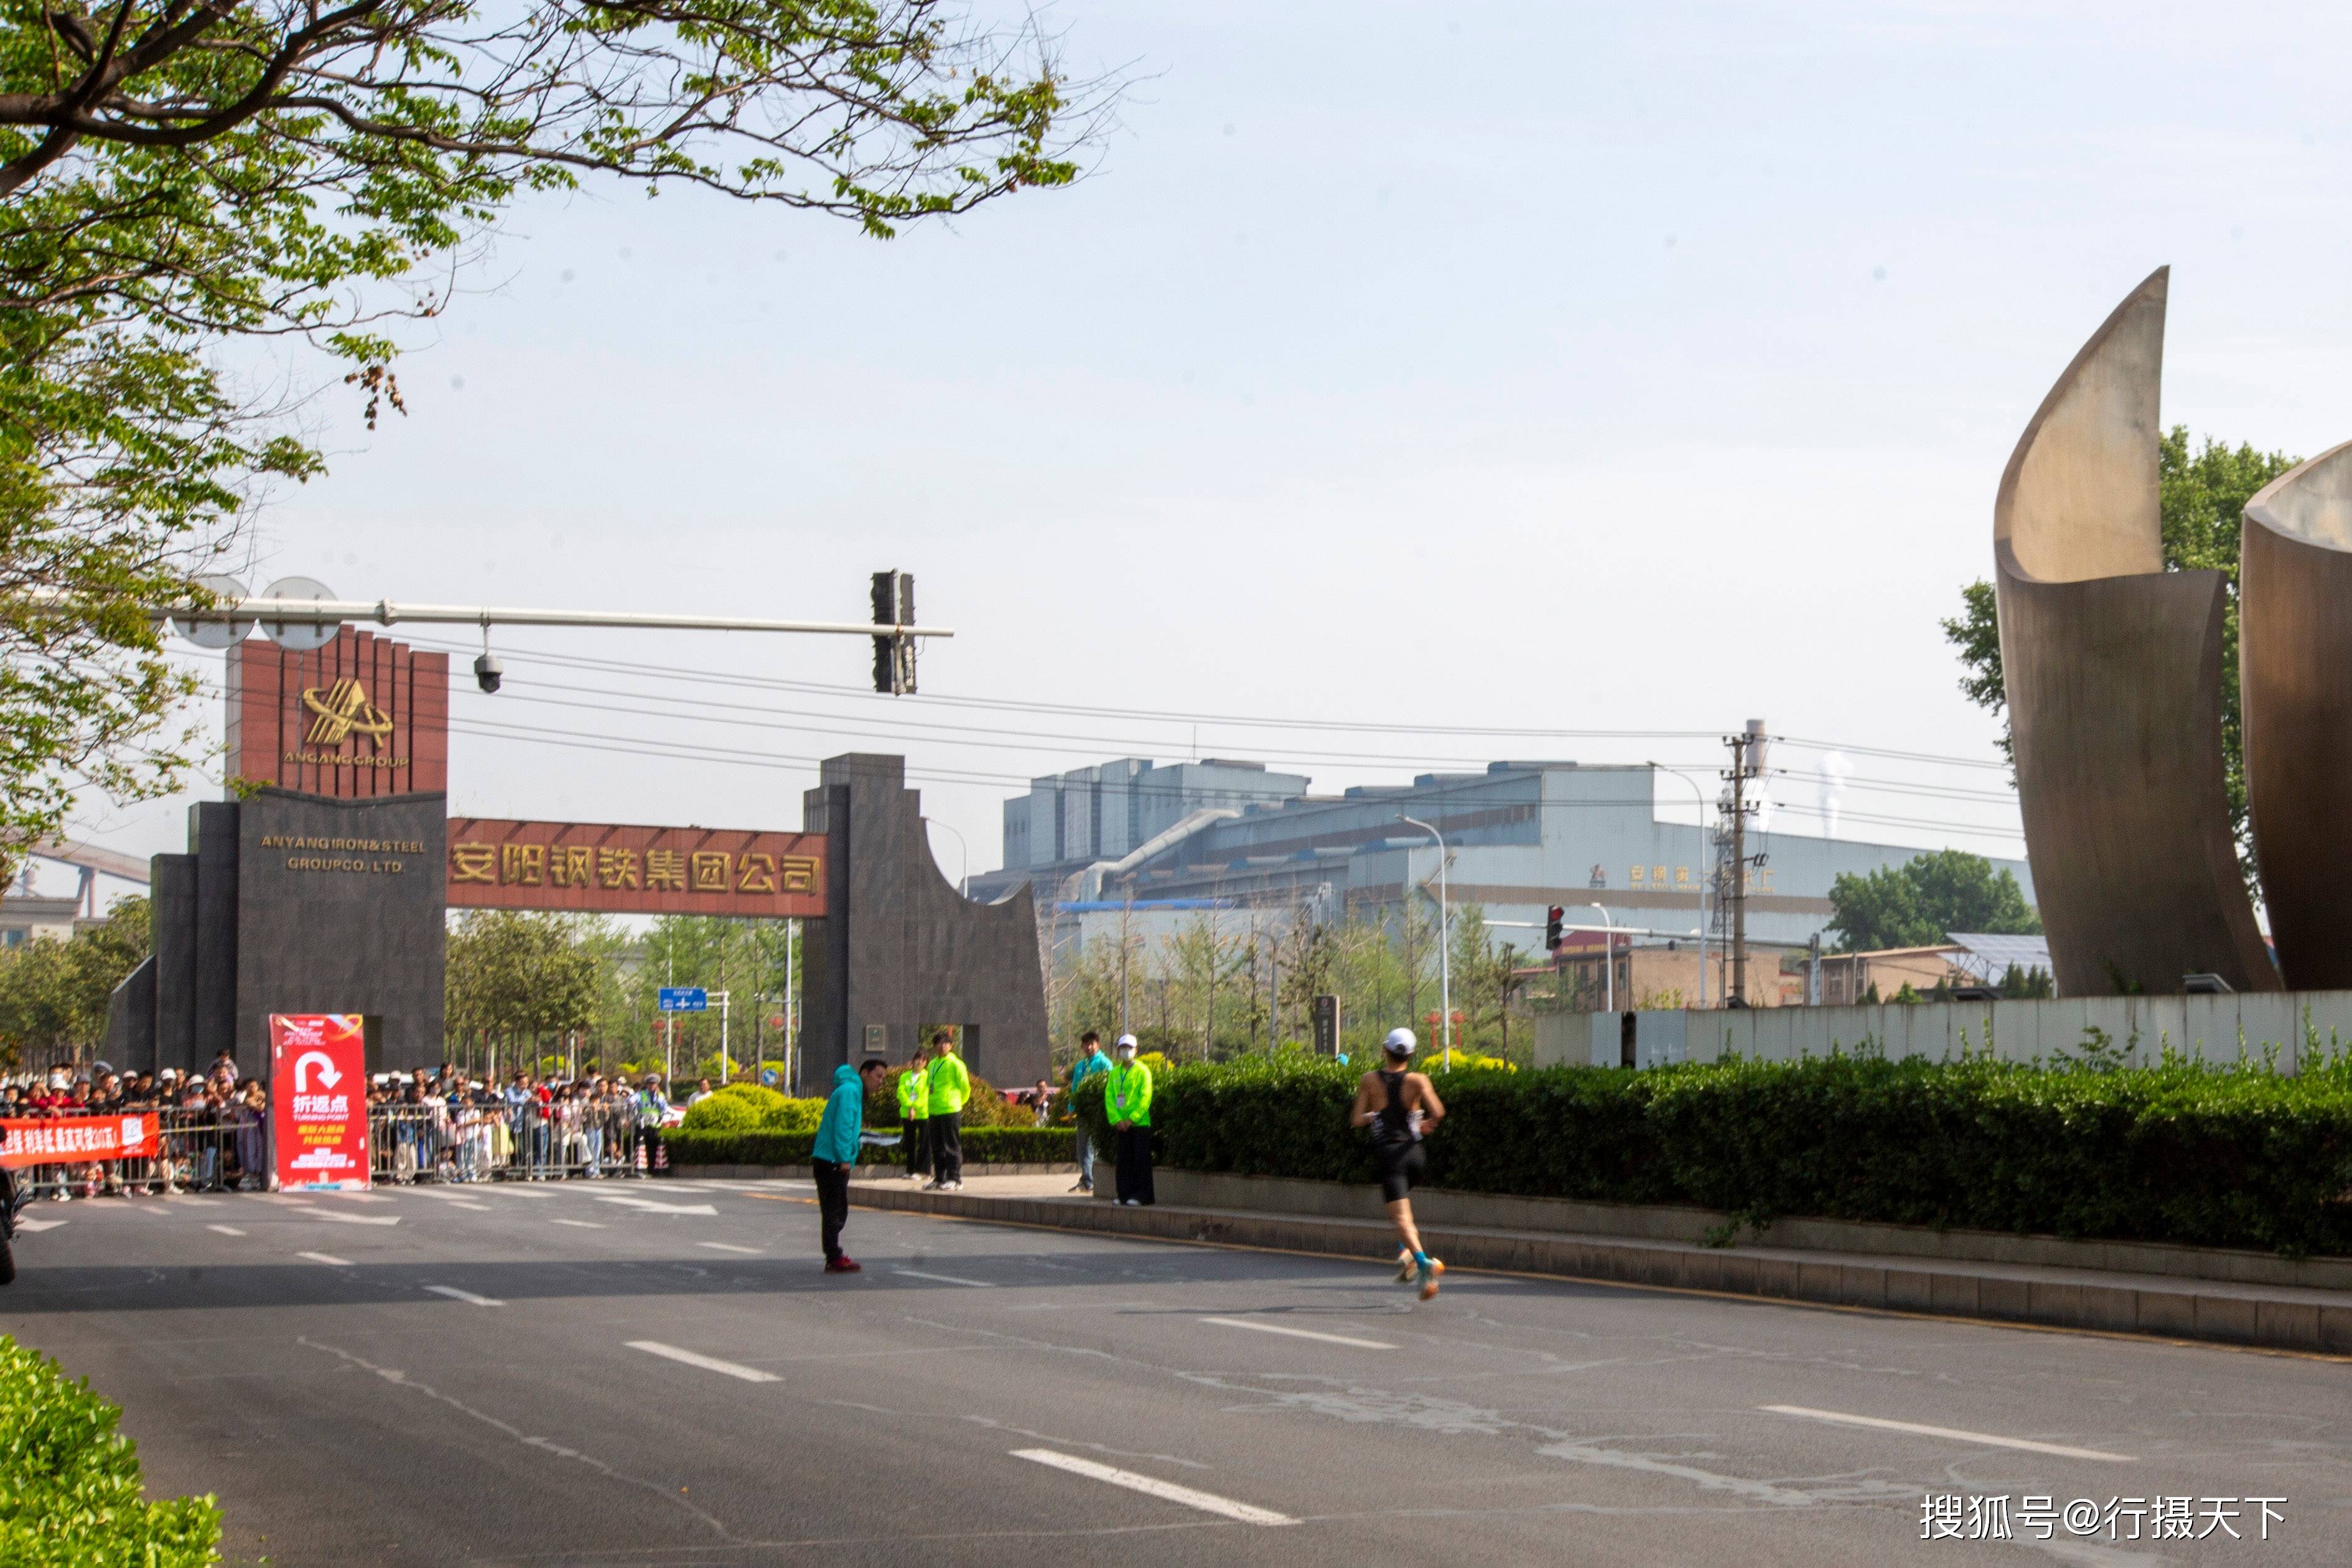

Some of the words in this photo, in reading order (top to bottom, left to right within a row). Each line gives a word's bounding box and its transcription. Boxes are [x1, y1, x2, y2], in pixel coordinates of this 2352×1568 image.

[353, 755, 410, 769] GROUP
[261, 835, 329, 851] ANYANG
[449, 841, 820, 895] 安阳钢铁集团公司
[292, 1094, 349, 1114] 折返点
